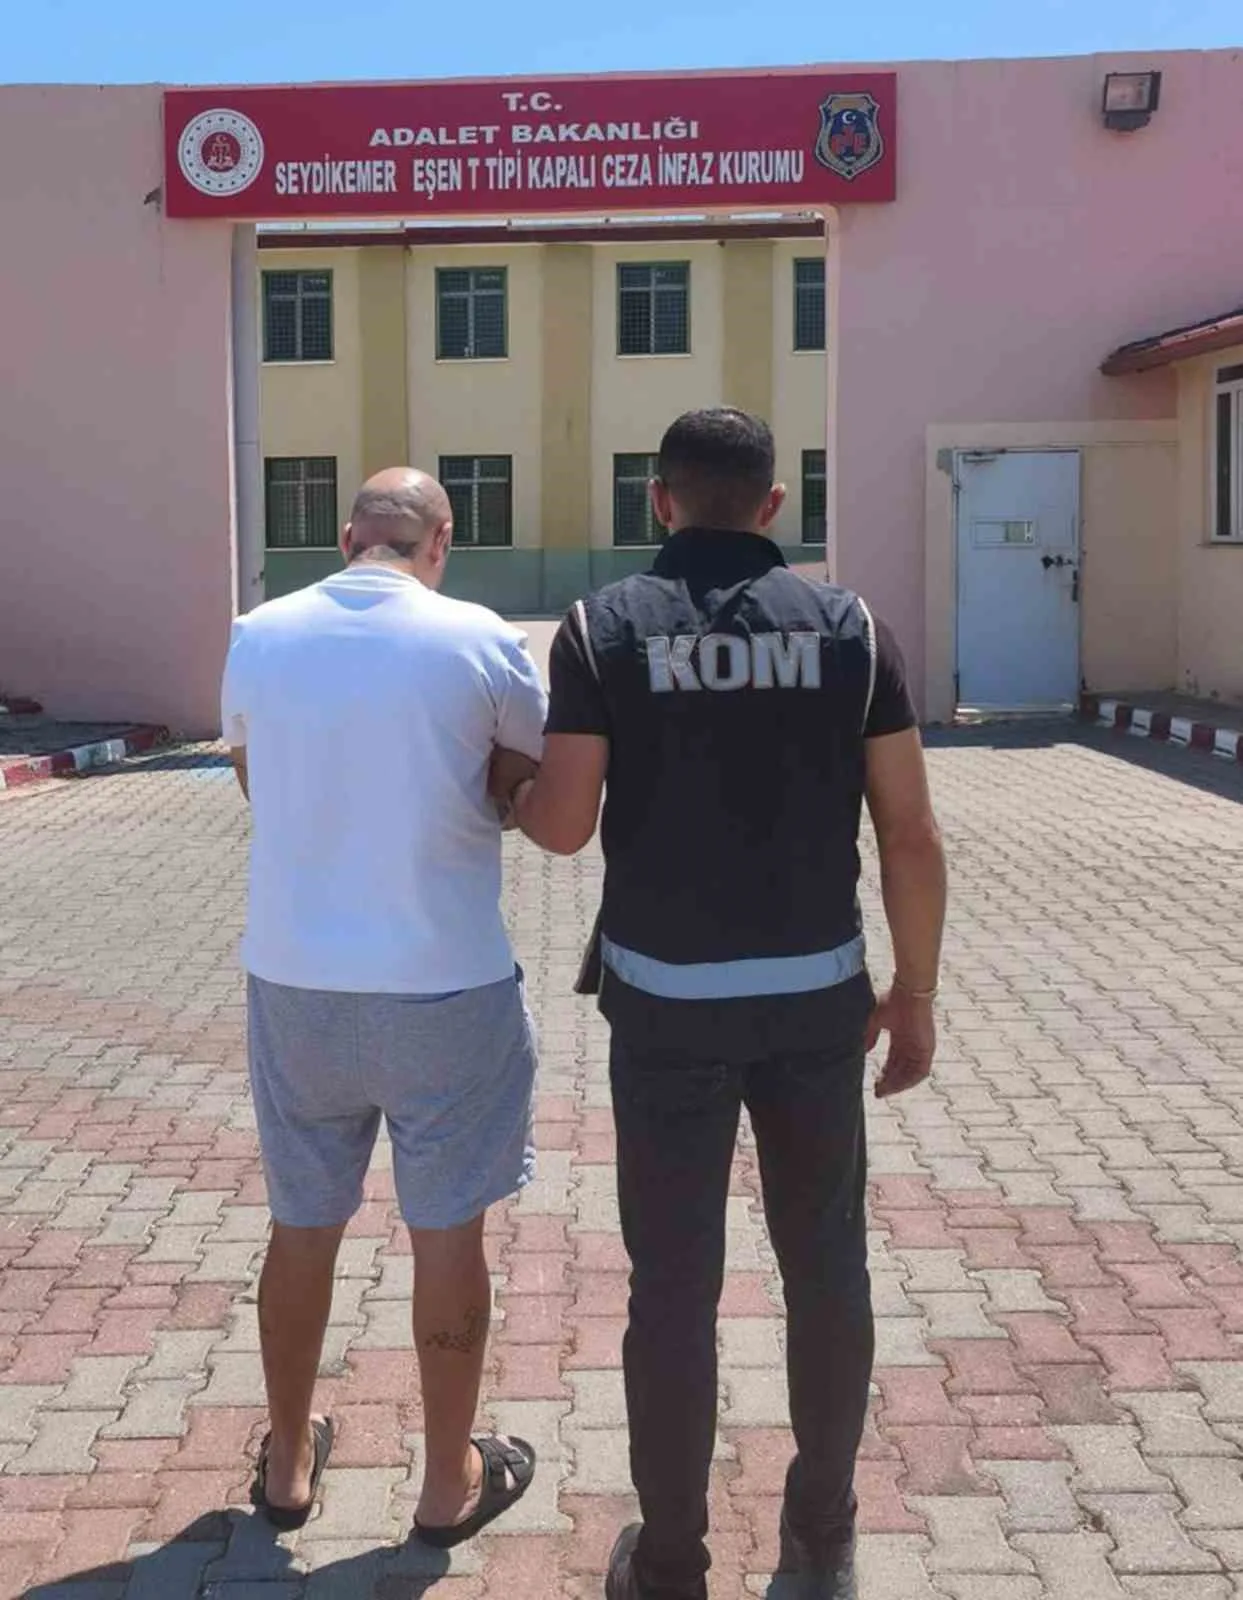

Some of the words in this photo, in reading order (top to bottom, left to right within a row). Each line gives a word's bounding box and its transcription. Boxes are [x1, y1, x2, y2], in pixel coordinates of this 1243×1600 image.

[502, 92, 562, 112] T.C.
[369, 126, 500, 147] ADALET
[511, 117, 699, 143] BAKANLIĞI
[275, 153, 397, 195] SEYDİKEMER
[412, 157, 462, 199] EŞEN
[467, 158, 480, 191] T
[484, 149, 522, 190] TİPİ
[527, 152, 597, 189] KAPALI
[602, 152, 652, 188] CEZA
[658, 145, 714, 186] İNFAZ
[719, 149, 804, 184] KURUMU
[646, 631, 821, 693] KOM
